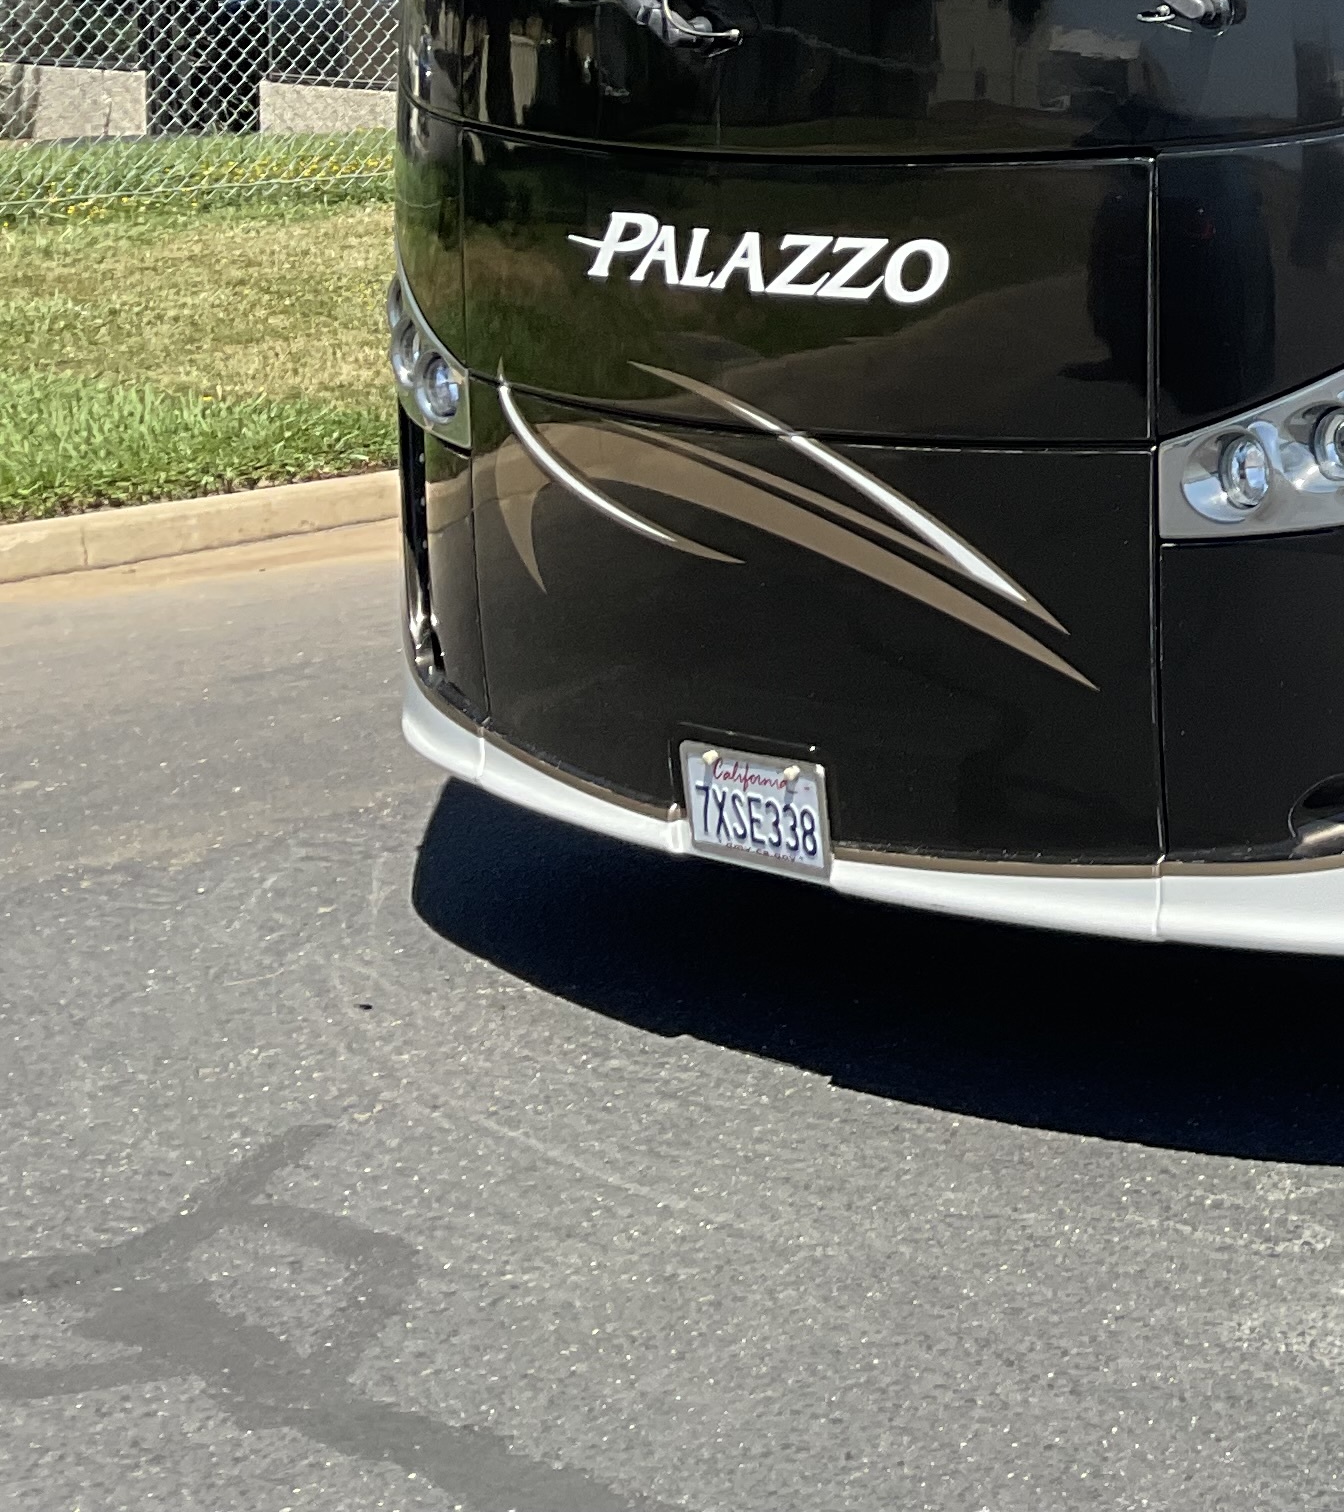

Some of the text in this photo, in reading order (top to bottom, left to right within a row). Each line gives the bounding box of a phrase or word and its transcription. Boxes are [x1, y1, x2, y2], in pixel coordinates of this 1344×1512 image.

[567, 211, 950, 304] PALAZZO
[712, 757, 788, 792] California
[695, 784, 817, 857] 7XSE338
